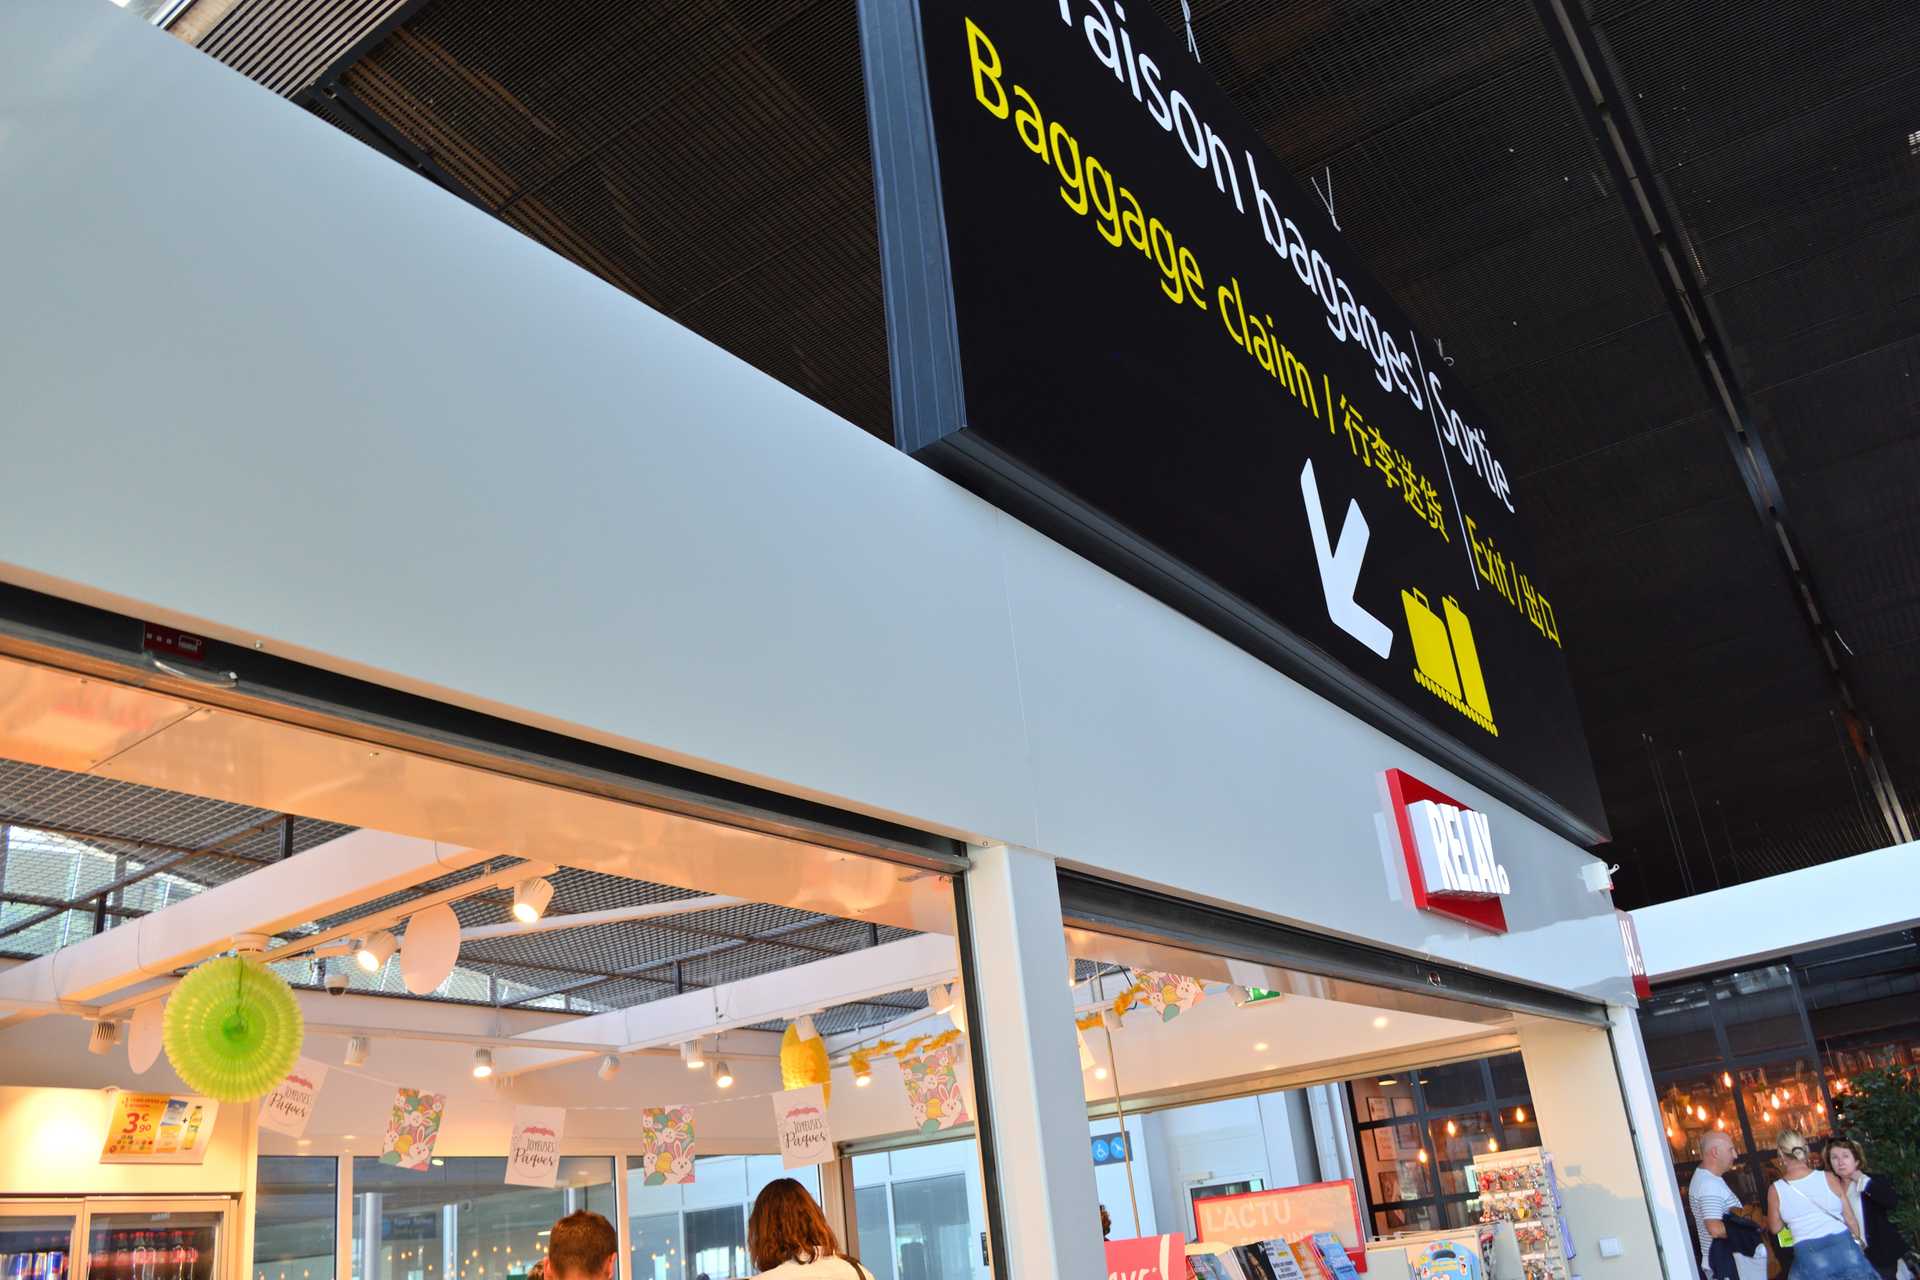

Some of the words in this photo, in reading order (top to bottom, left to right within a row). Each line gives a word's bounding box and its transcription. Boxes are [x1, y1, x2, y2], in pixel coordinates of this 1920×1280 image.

[964, 16, 1207, 310] Baggage
[1217, 277, 1319, 418] claim
[1245, 150, 1423, 410] bagages
[1429, 371, 1515, 513] Sortie
[1465, 514, 1515, 606] Exit
[1520, 575, 1561, 648] 出口
[1205, 1197, 1292, 1233] L'ACTU
